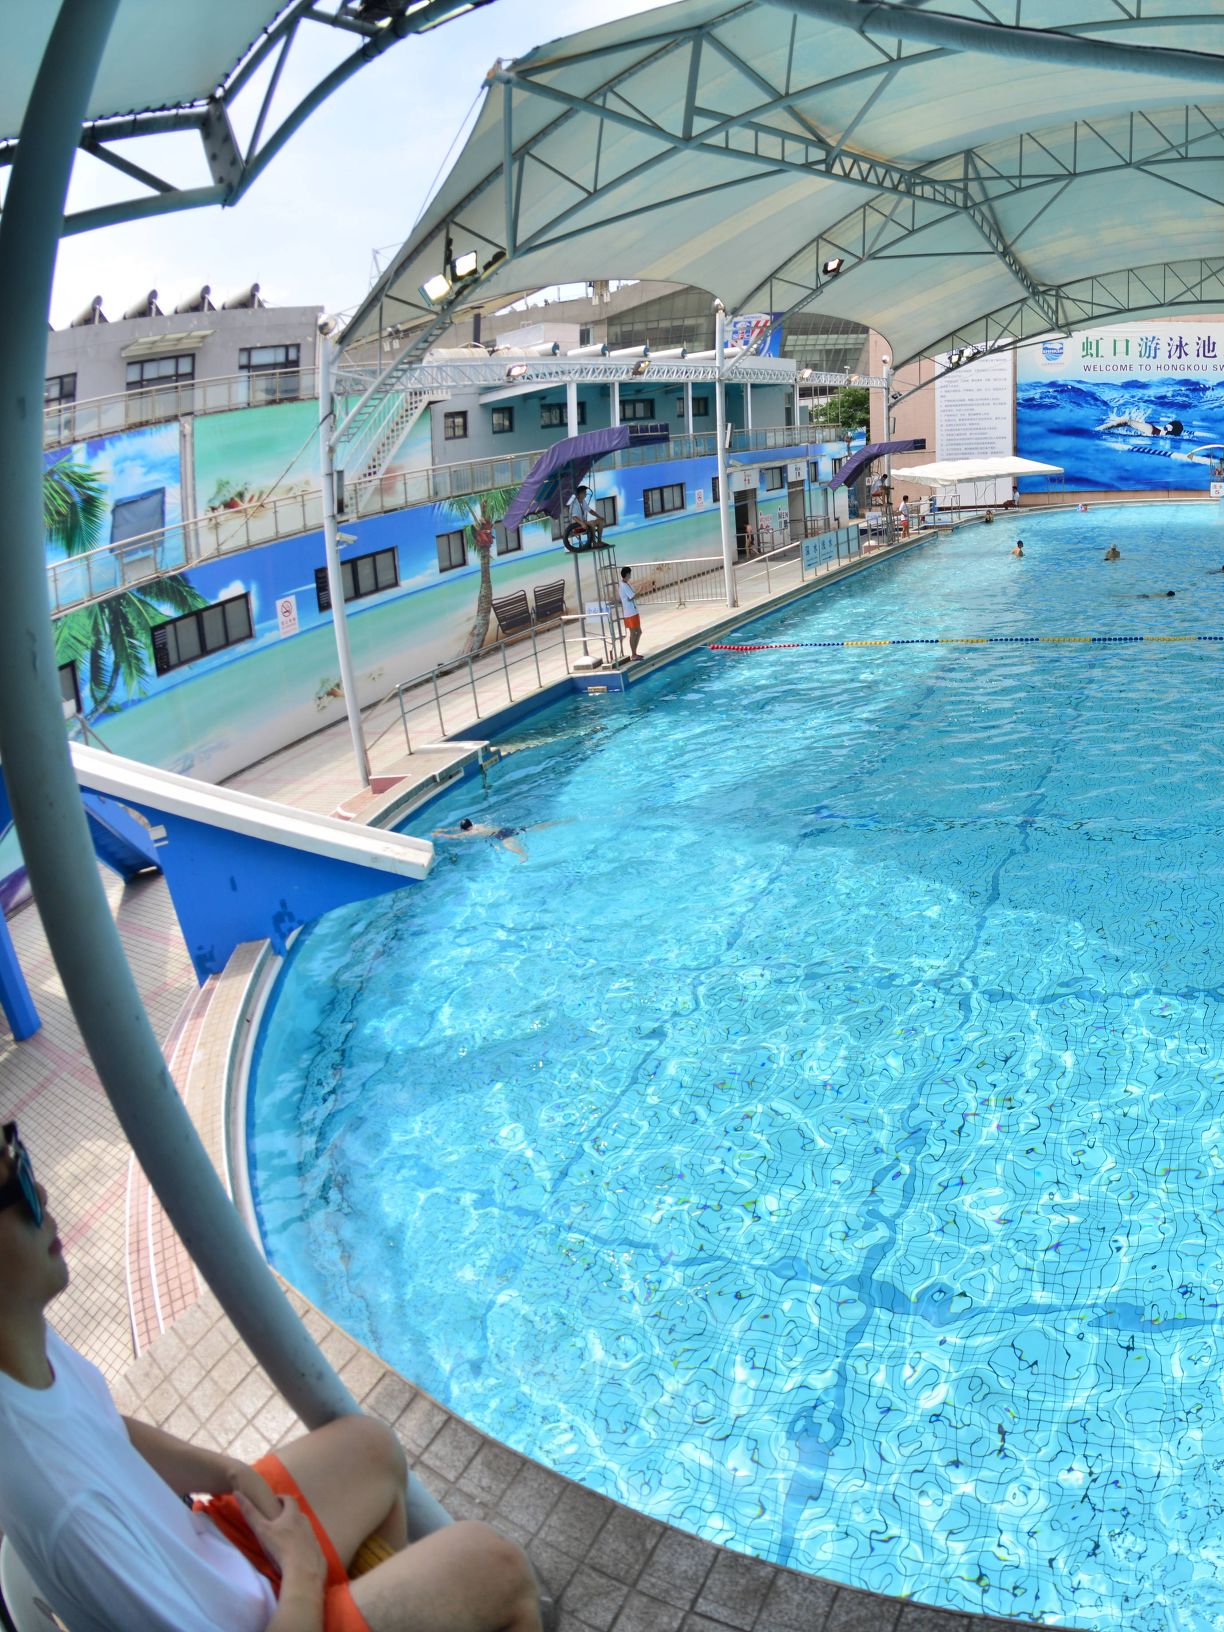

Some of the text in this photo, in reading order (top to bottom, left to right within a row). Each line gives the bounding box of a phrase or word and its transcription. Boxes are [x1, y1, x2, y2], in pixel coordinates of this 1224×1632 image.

[1083, 364, 1134, 372] WELCOME
[1138, 364, 1152, 372] TO
[1156, 364, 1208, 372] HONGKOU
